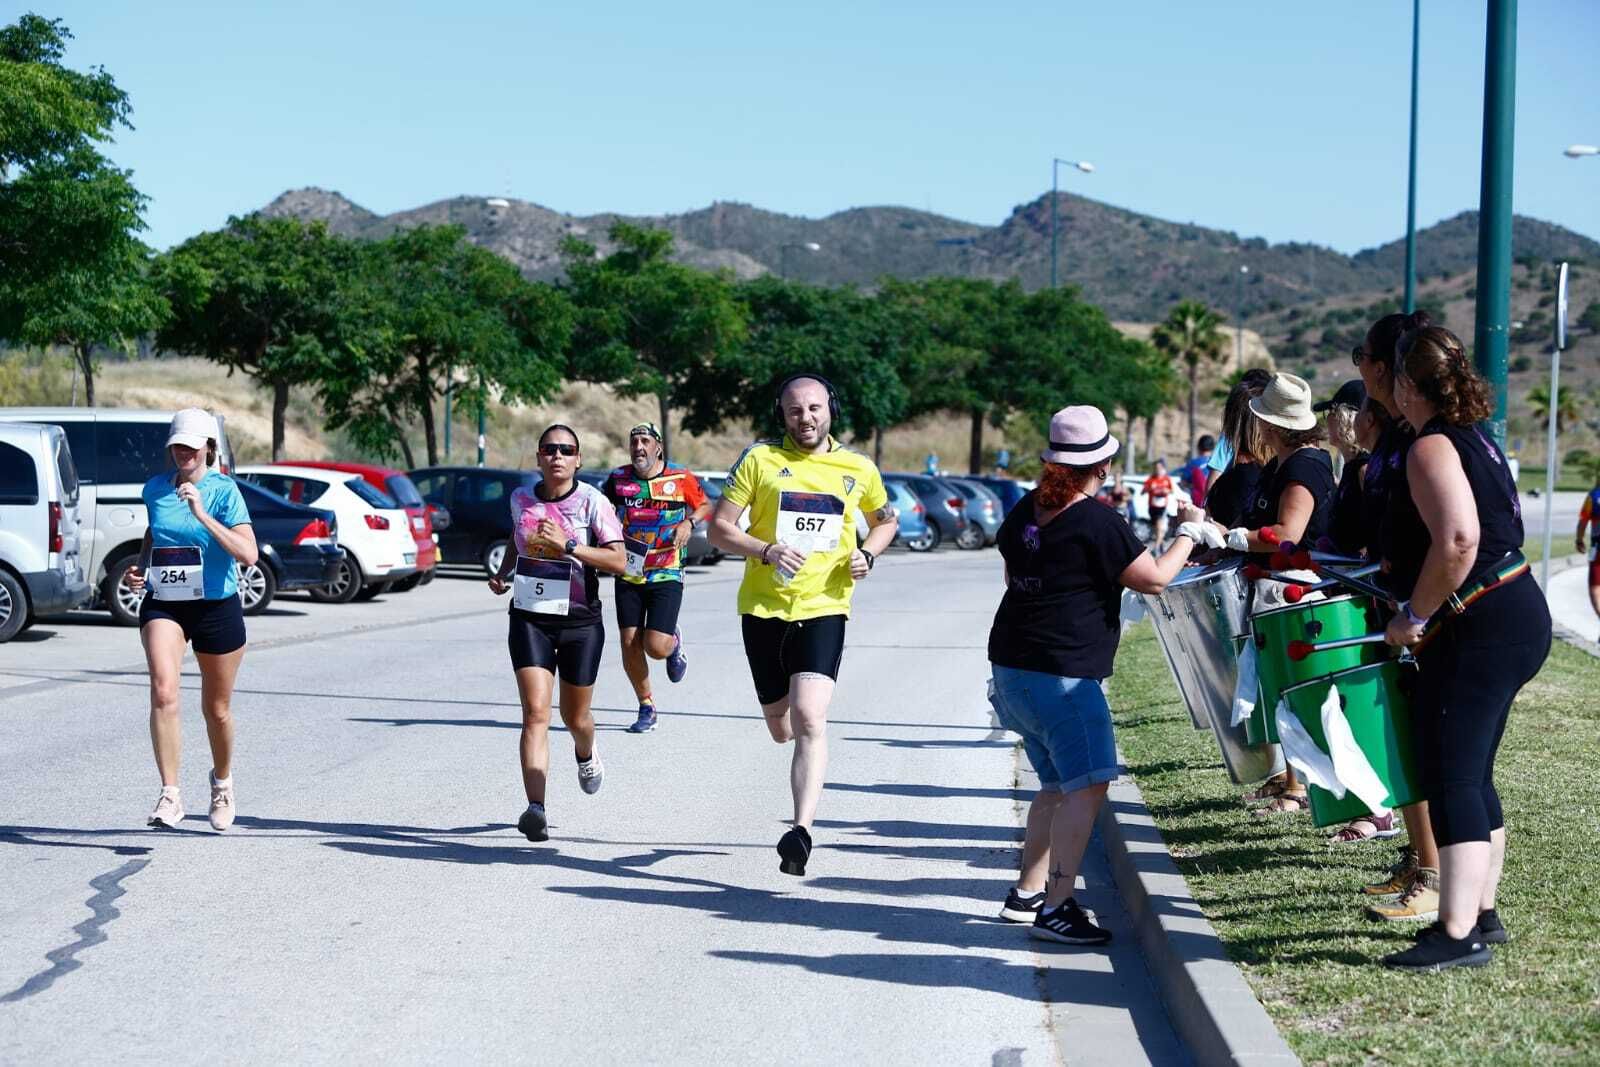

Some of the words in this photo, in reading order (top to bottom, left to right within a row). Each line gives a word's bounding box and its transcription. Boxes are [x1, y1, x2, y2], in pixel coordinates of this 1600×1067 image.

[795, 516, 826, 532] 657
[160, 569, 187, 584] 254
[535, 582, 544, 596] 5
